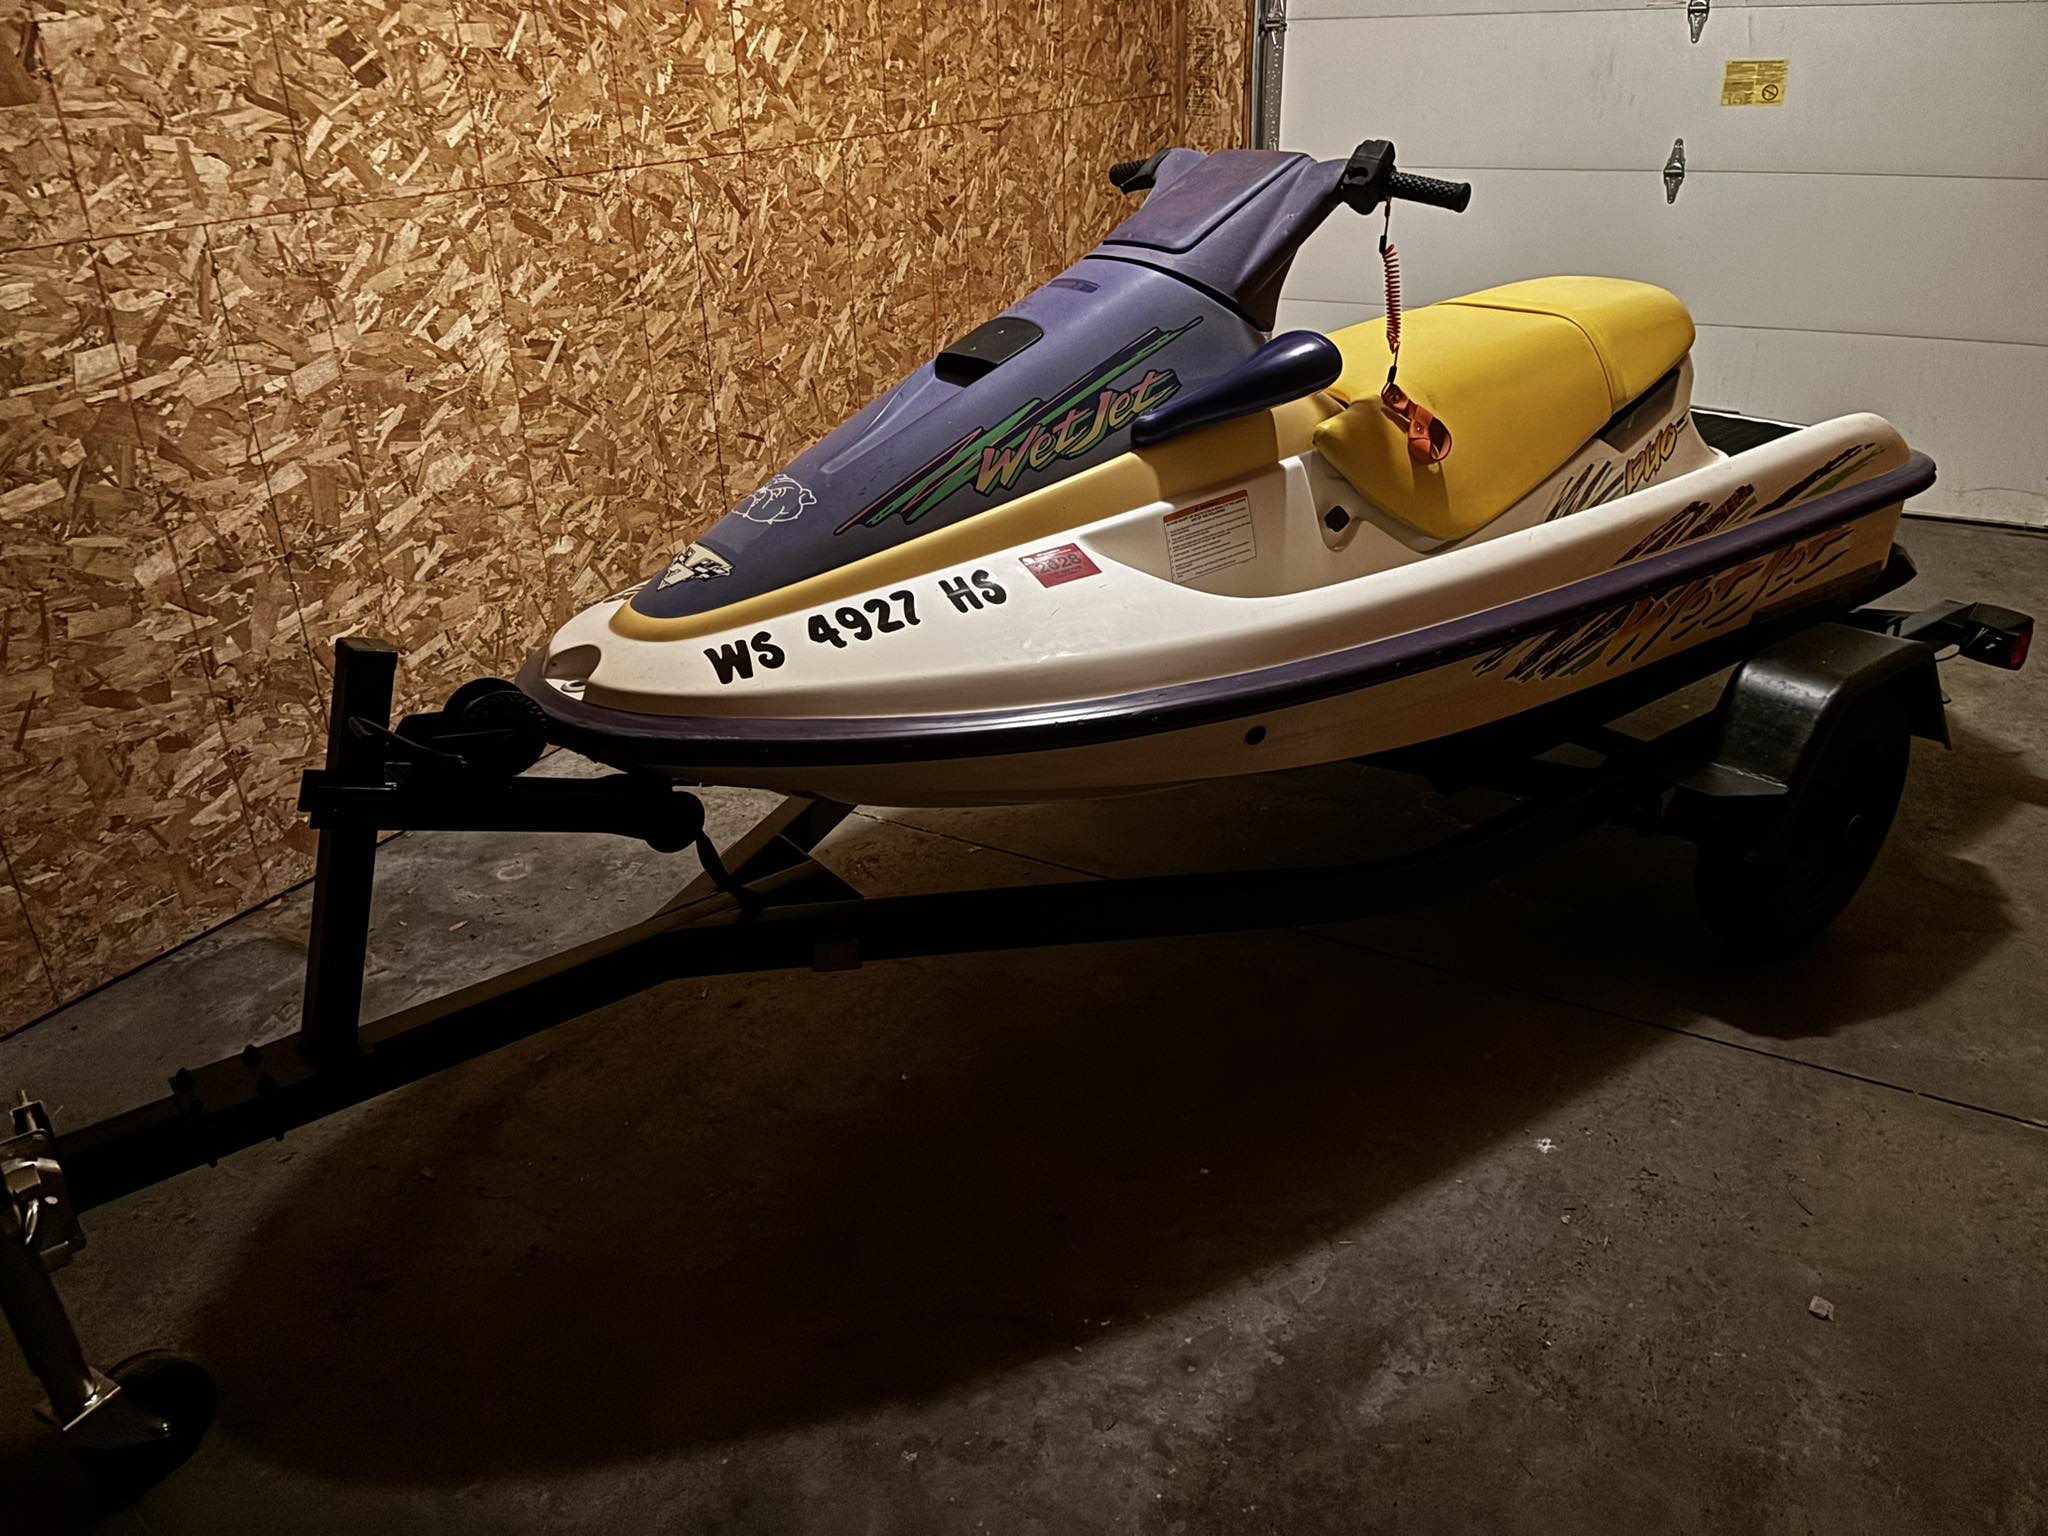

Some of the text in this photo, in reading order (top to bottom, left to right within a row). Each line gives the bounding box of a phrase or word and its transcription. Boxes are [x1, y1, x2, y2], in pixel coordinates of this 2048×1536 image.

[974, 368, 1182, 495] WetJet
[703, 570, 1007, 684] WS 4927 HS
